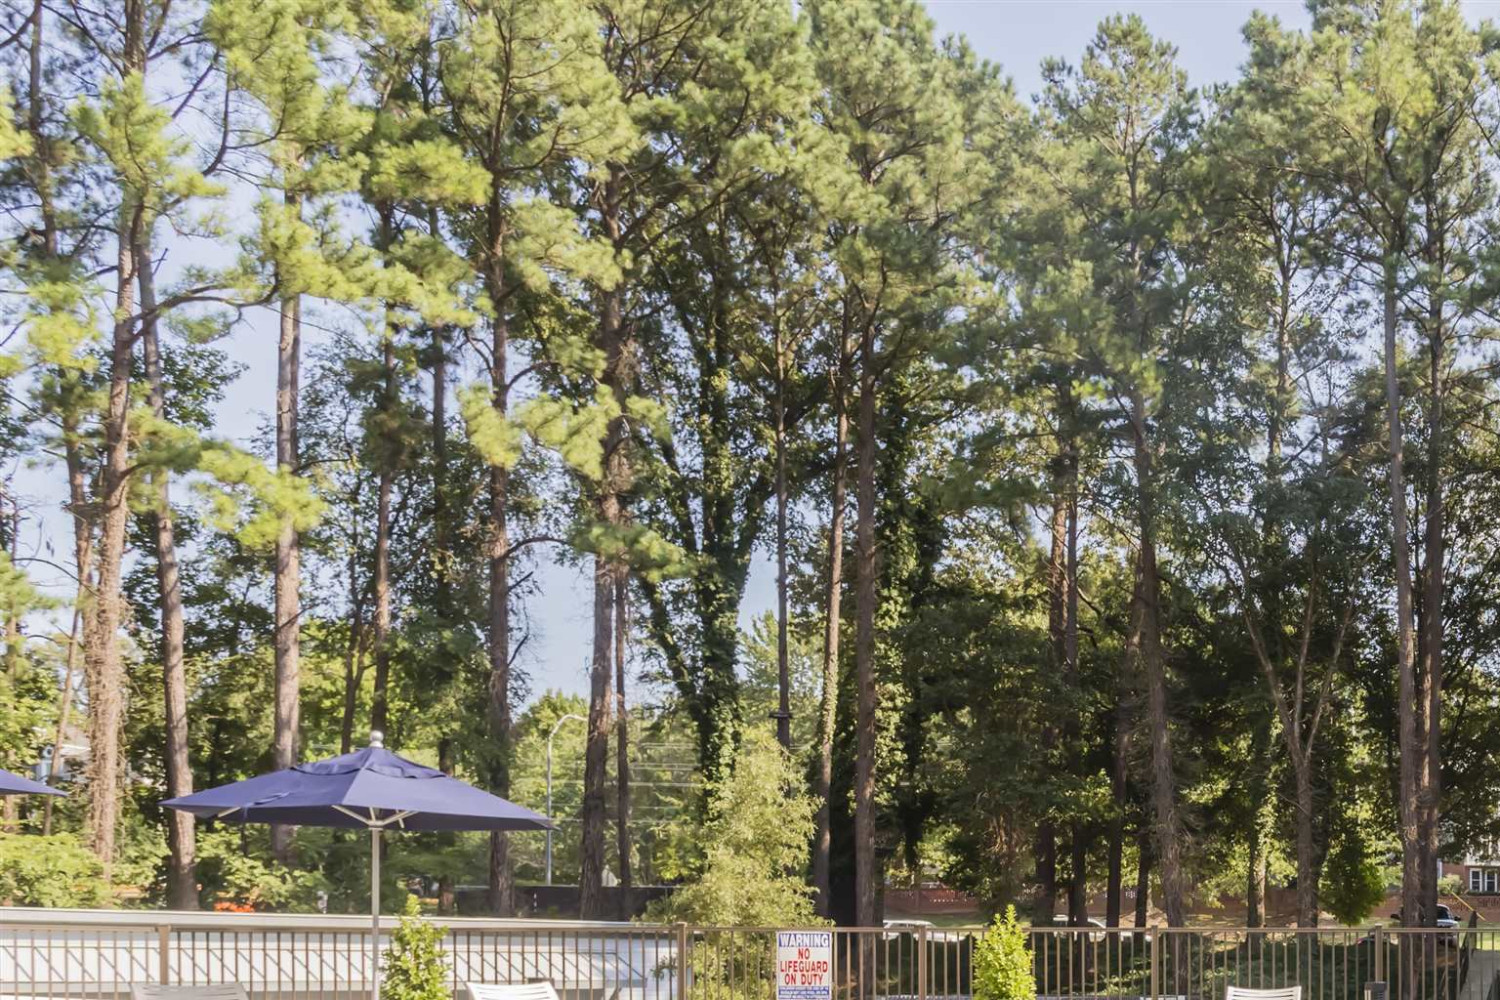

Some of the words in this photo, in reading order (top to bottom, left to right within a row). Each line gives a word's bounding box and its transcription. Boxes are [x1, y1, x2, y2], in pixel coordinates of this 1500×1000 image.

[780, 934, 829, 947] WARNING
[798, 948, 810, 960] NO
[780, 961, 828, 972] LIFEGUARD
[785, 973, 796, 985] ON
[801, 973, 824, 985] DUTY
